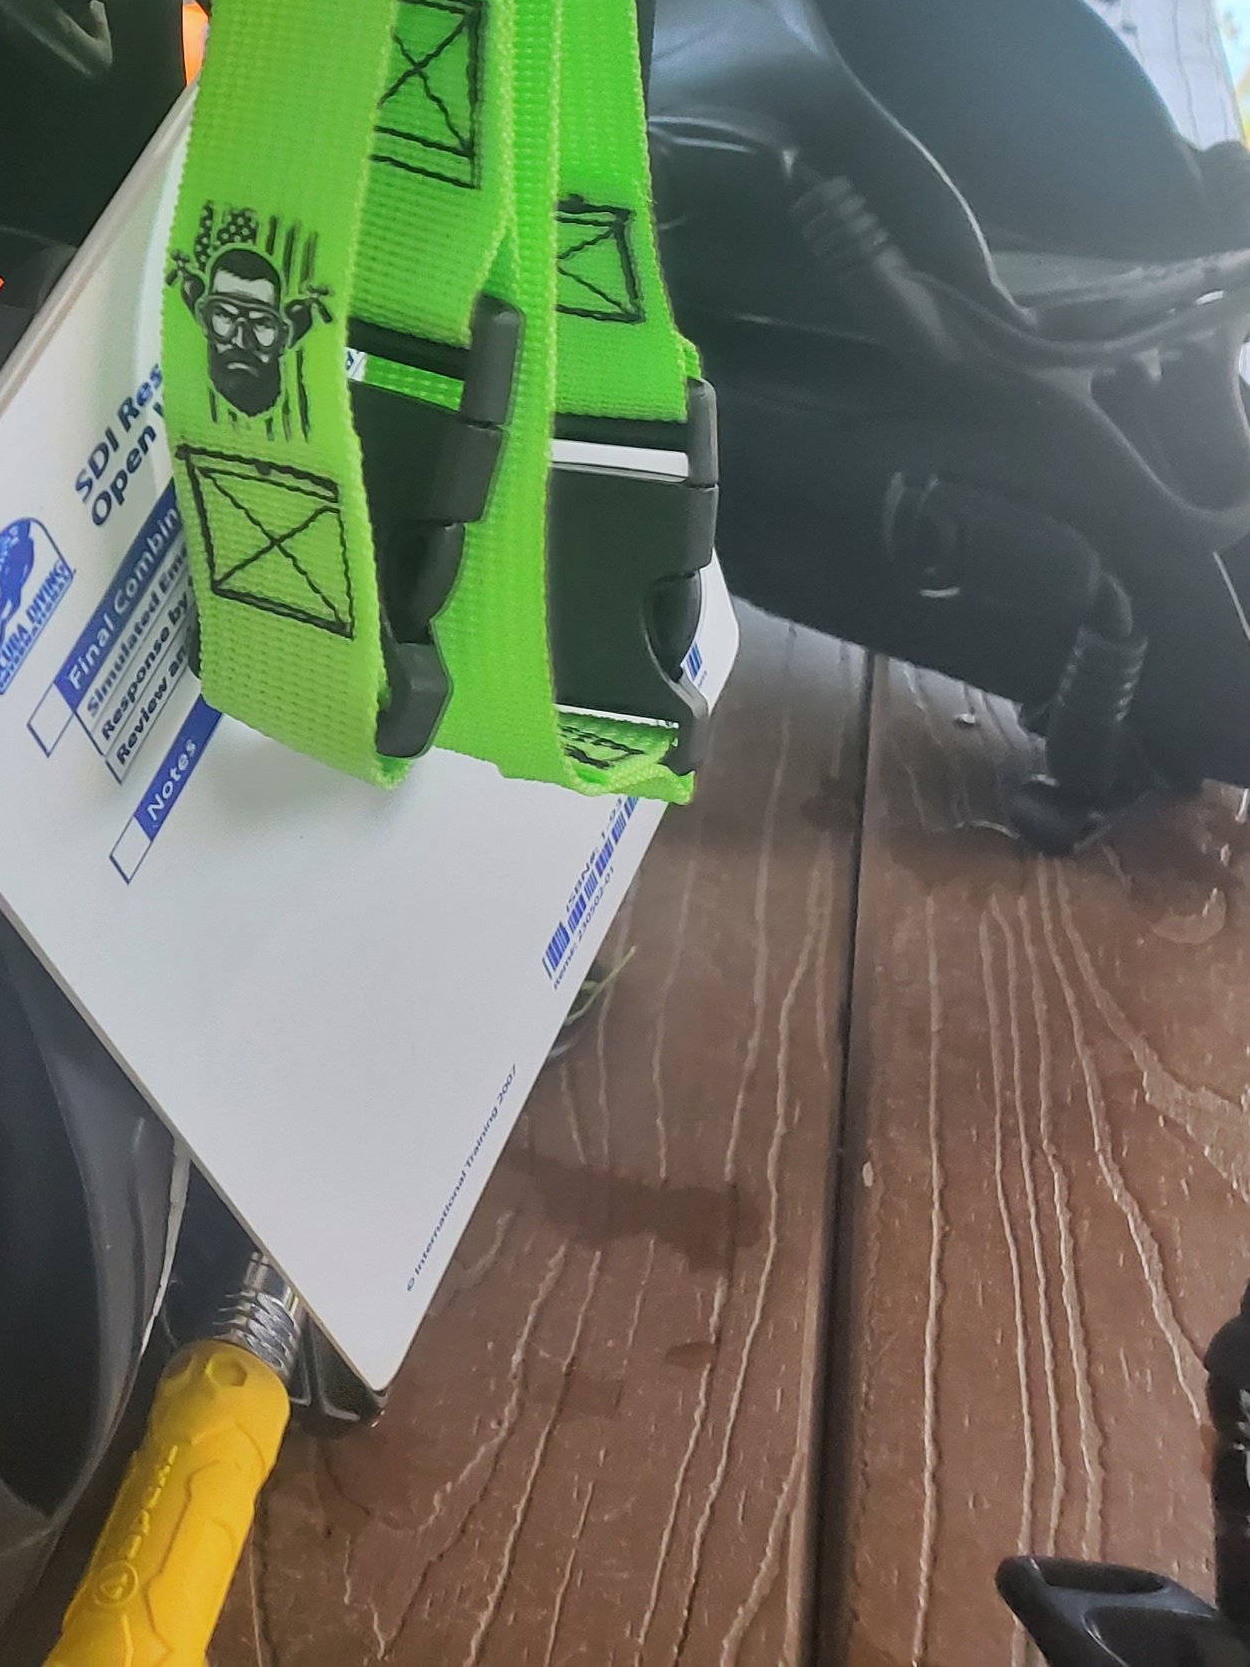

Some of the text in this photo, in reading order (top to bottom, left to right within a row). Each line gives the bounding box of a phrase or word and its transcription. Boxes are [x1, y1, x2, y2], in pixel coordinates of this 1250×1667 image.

[75, 426, 120, 504] SDI
[92, 425, 156, 526] Open
[26, 559, 65, 624] DIVING
[69, 614, 114, 690] Final
[87, 590, 160, 719] Simulated
[102, 592, 189, 740] Response by
[116, 677, 168, 765] Review
[146, 738, 197, 821] Notes
[577, 865, 615, 942] 230502-01
[415, 1169, 466, 1275] International
[464, 1106, 498, 1168] Training
[496, 1063, 517, 1106] 2007
